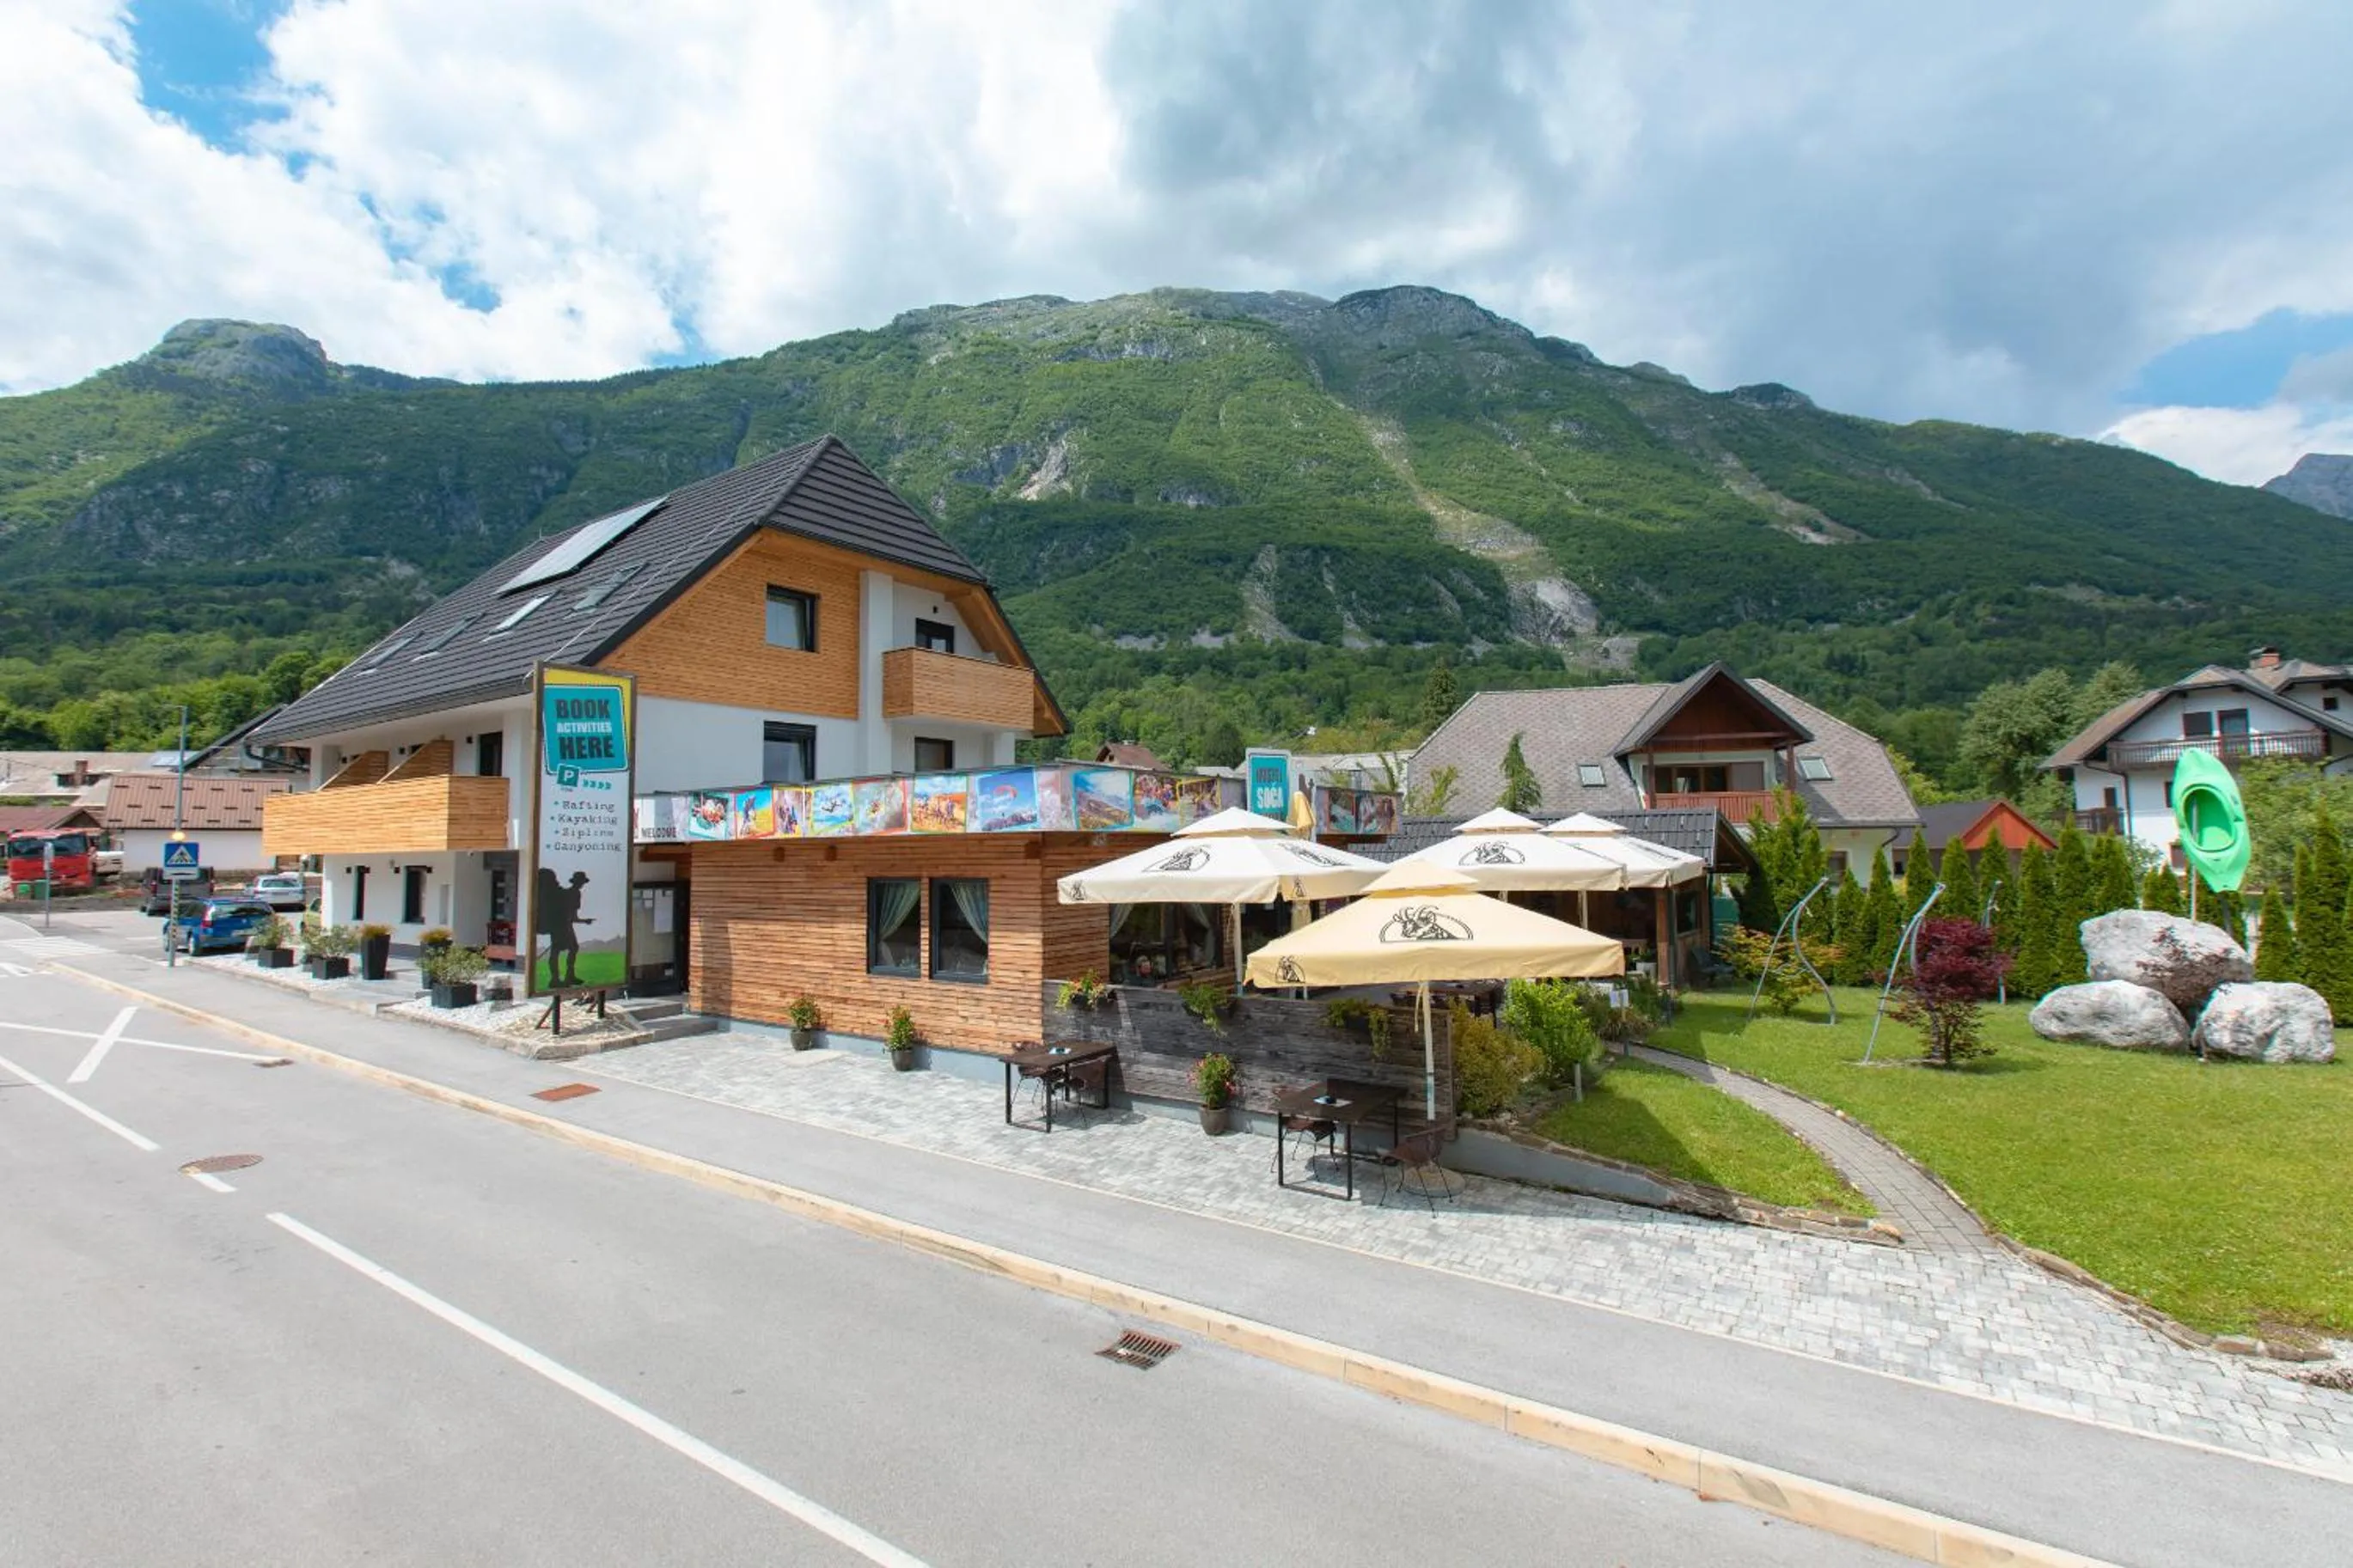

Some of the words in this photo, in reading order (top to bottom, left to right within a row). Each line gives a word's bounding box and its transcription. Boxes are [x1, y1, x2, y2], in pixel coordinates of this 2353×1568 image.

[555, 699, 610, 718] BOOK
[556, 722, 612, 733] ACTIVITIES
[558, 735, 615, 760] HERE
[562, 801, 615, 812] Rafting
[558, 814, 617, 825] Kayaking
[562, 827, 614, 839] Zipline
[641, 827, 677, 839] WELCOME
[554, 842, 622, 852] Canyoning
